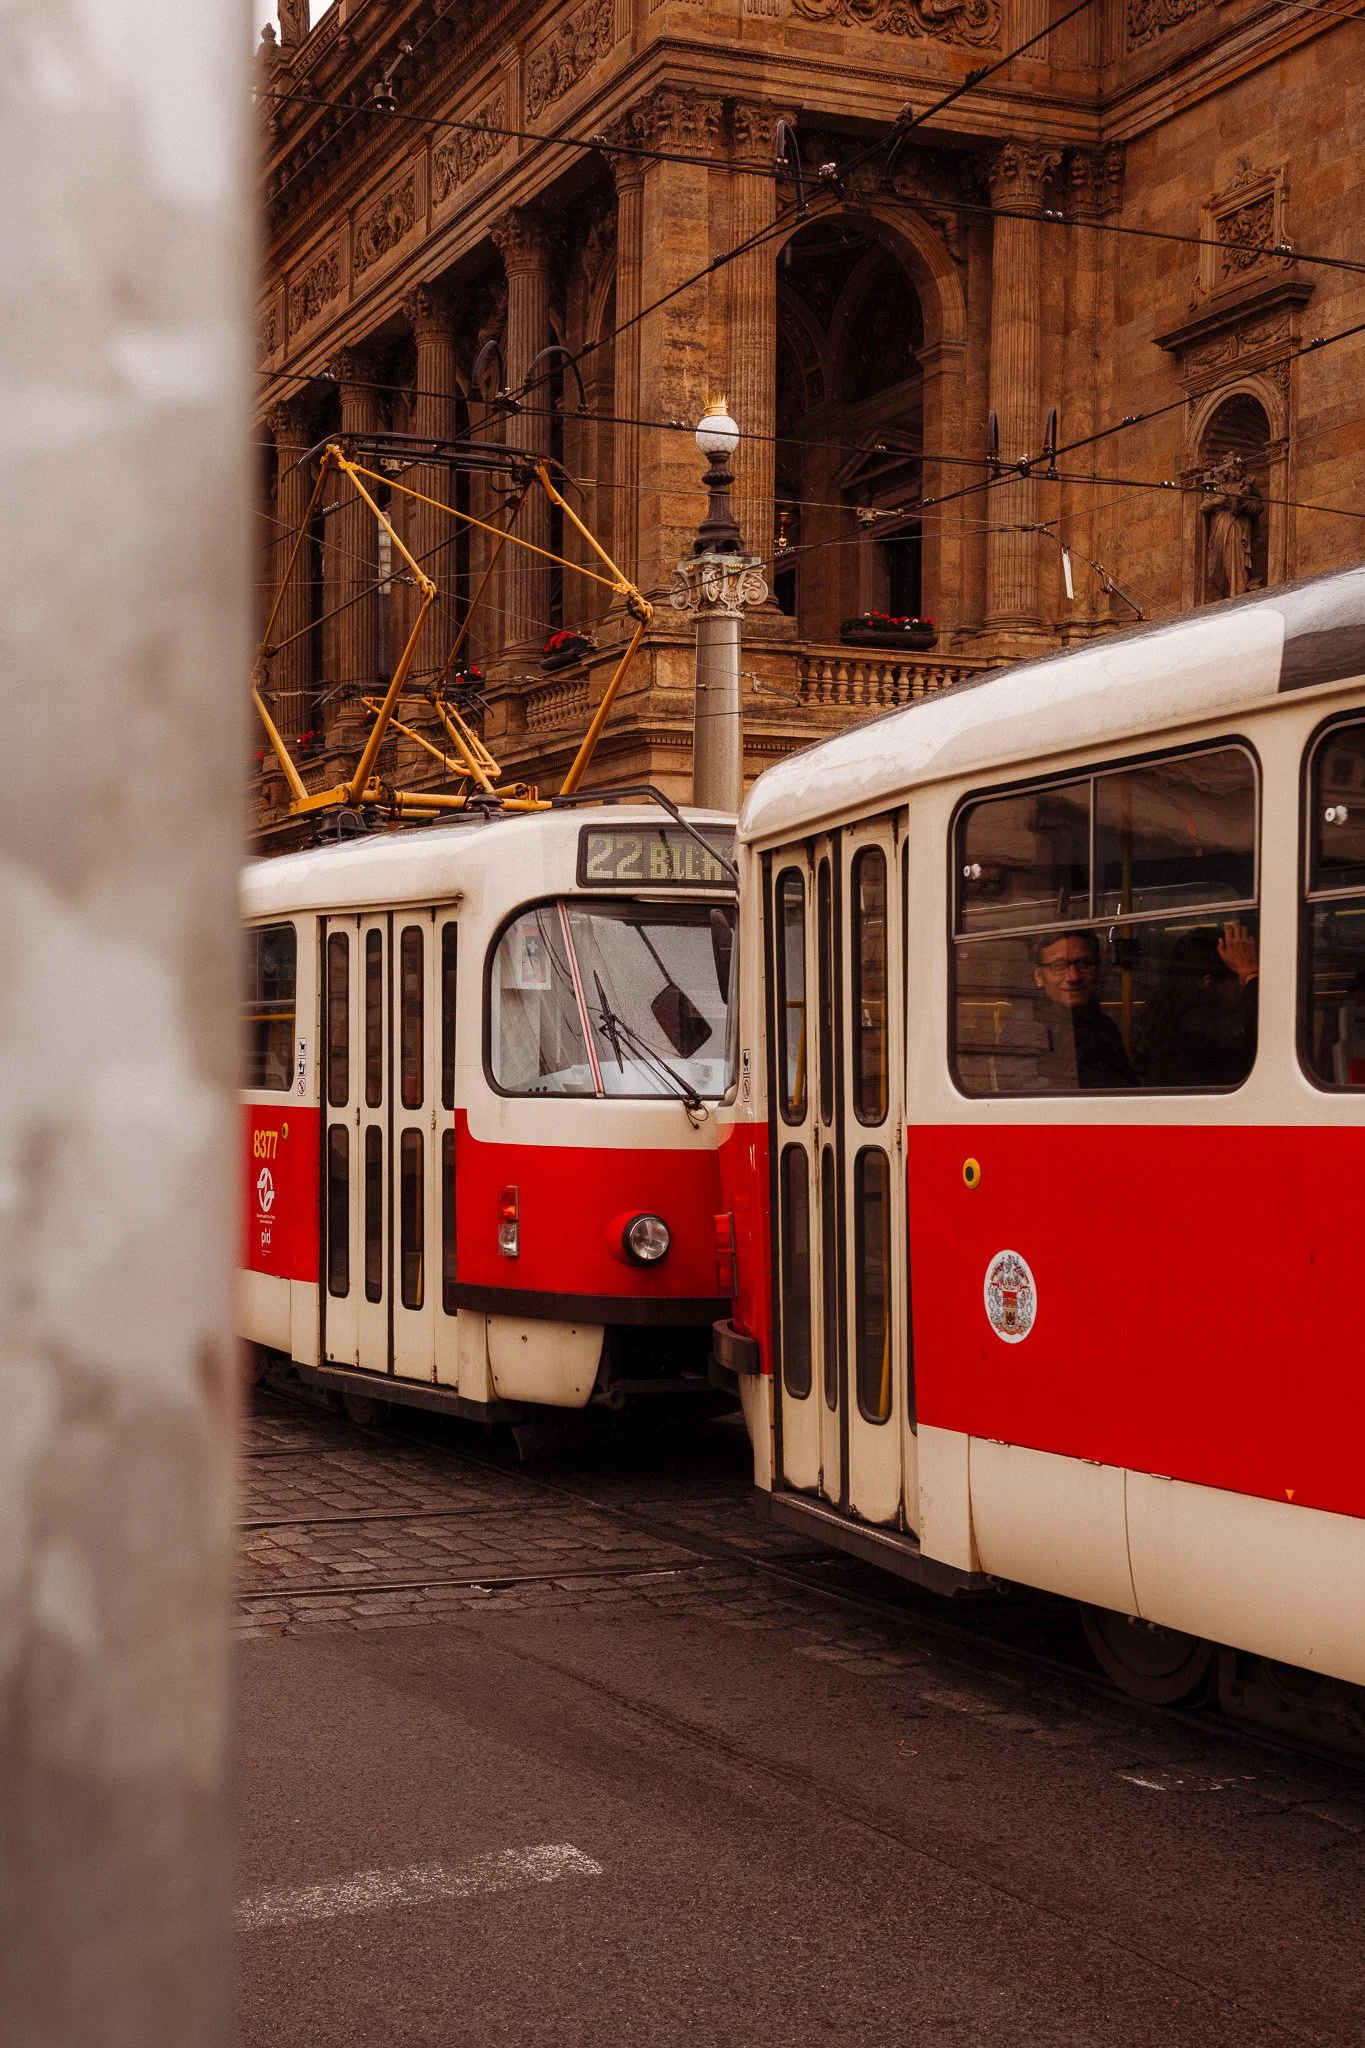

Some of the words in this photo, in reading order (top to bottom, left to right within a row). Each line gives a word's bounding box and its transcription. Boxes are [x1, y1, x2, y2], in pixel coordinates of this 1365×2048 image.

[587, 835, 643, 880] 22
[253, 1129, 278, 1159] 8377
[261, 1228, 271, 1247] pid
